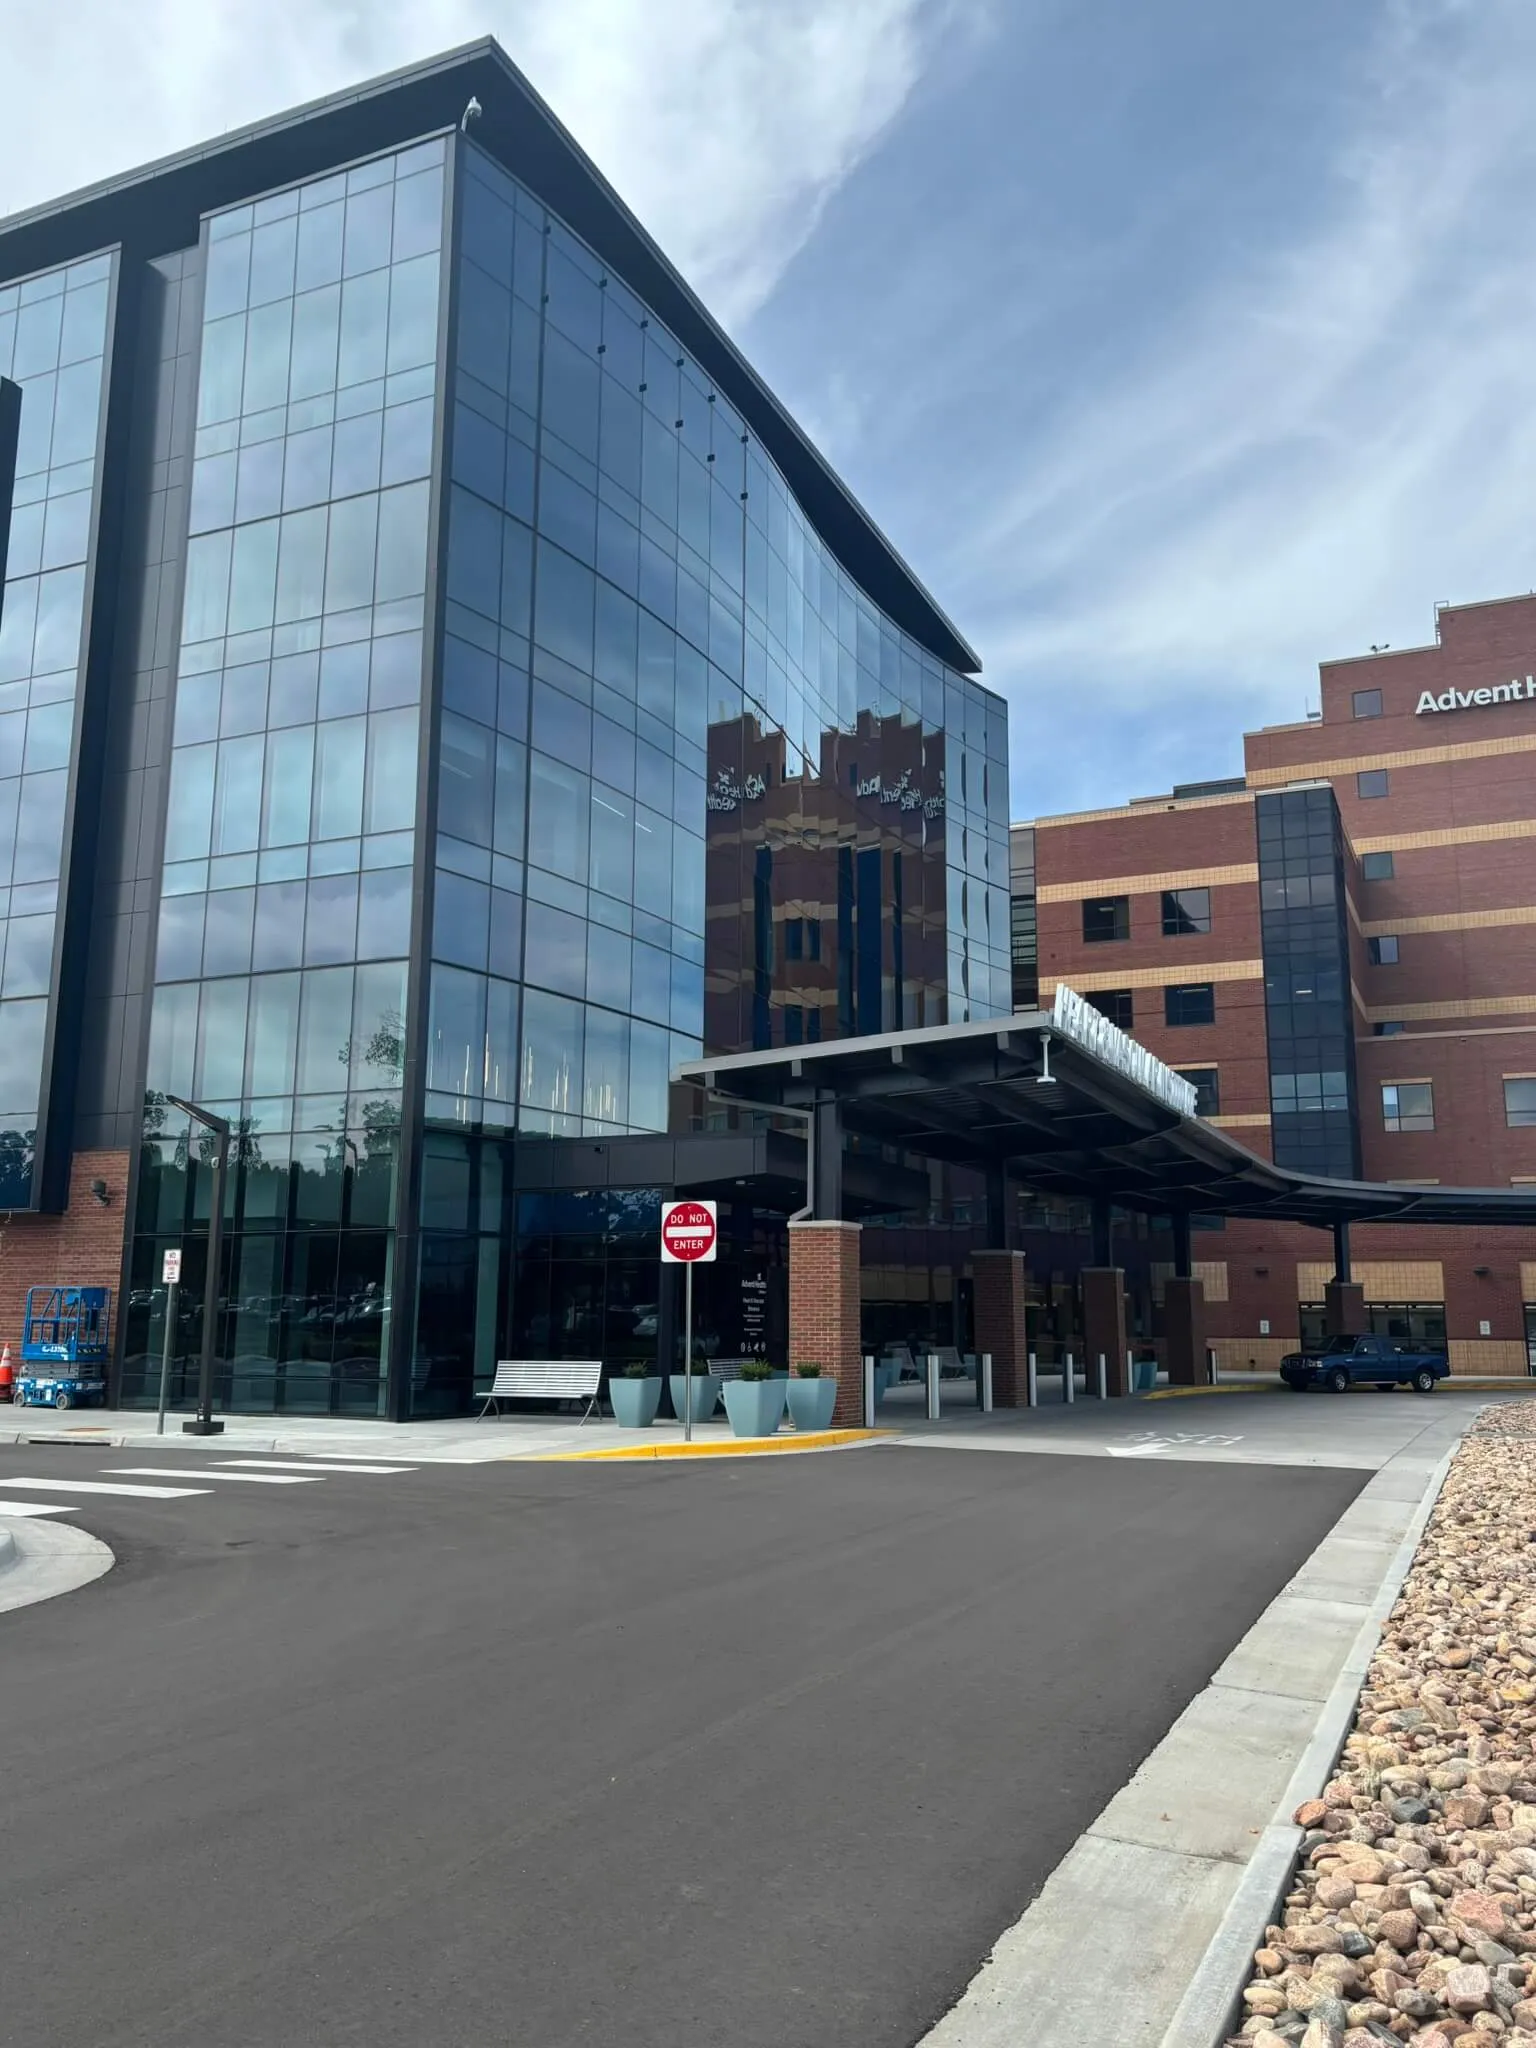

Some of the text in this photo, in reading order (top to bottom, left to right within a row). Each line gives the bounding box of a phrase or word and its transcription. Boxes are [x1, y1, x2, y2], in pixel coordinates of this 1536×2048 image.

[671, 1213, 708, 1224] DO NOT
[673, 1240, 704, 1250] ENTER
